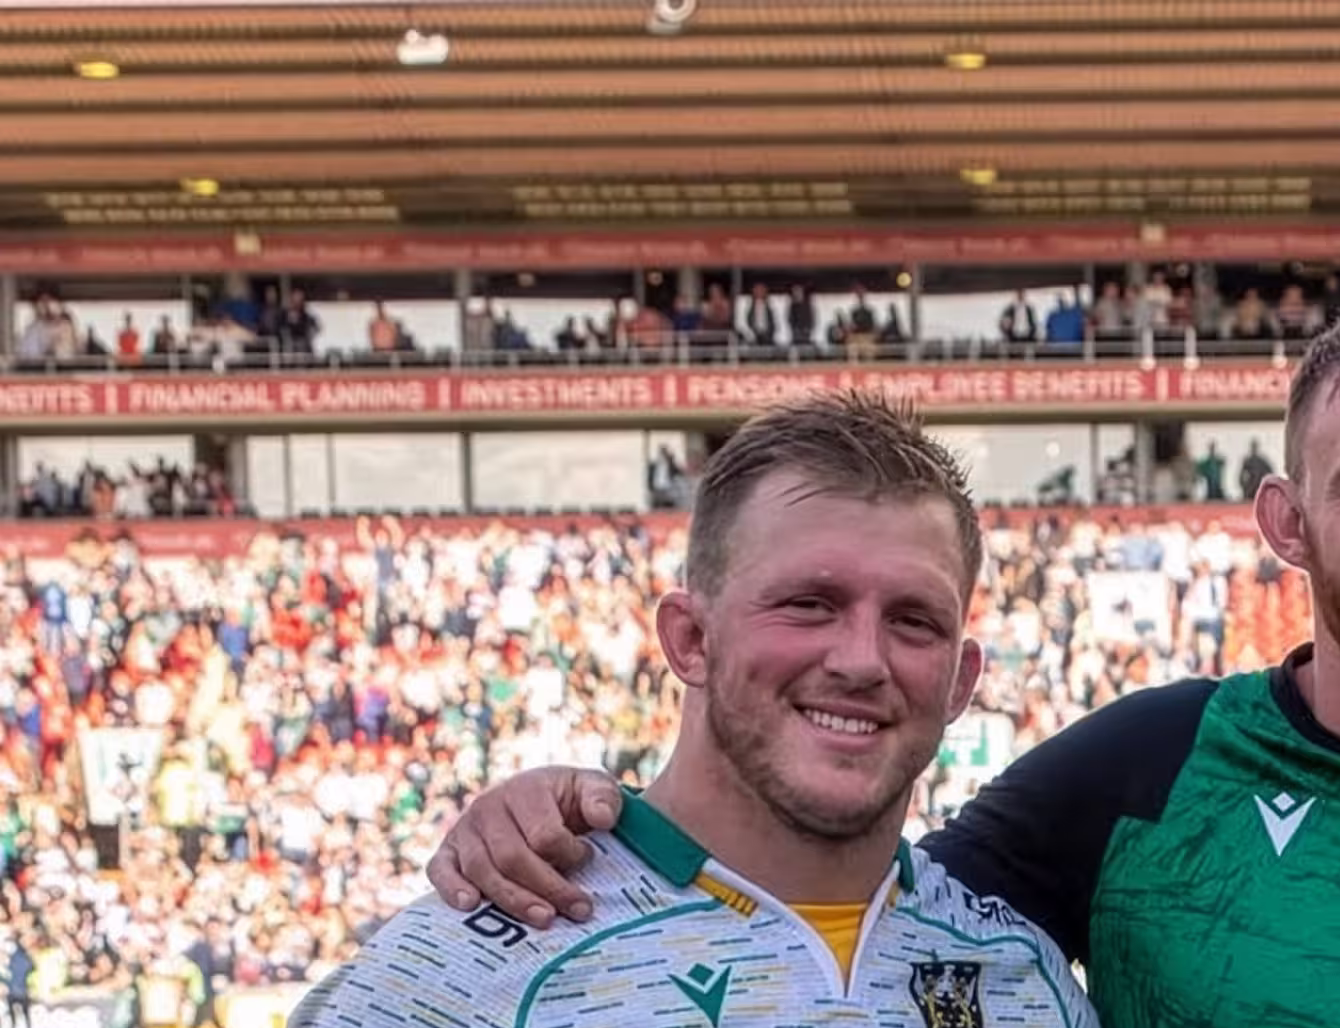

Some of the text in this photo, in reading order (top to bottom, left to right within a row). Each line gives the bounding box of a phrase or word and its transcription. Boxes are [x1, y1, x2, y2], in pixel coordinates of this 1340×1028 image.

[280, 381, 424, 410] PLANNING
[461, 377, 652, 408] INVESTMENTS
[1012, 370, 1143, 400] BENEFITS
